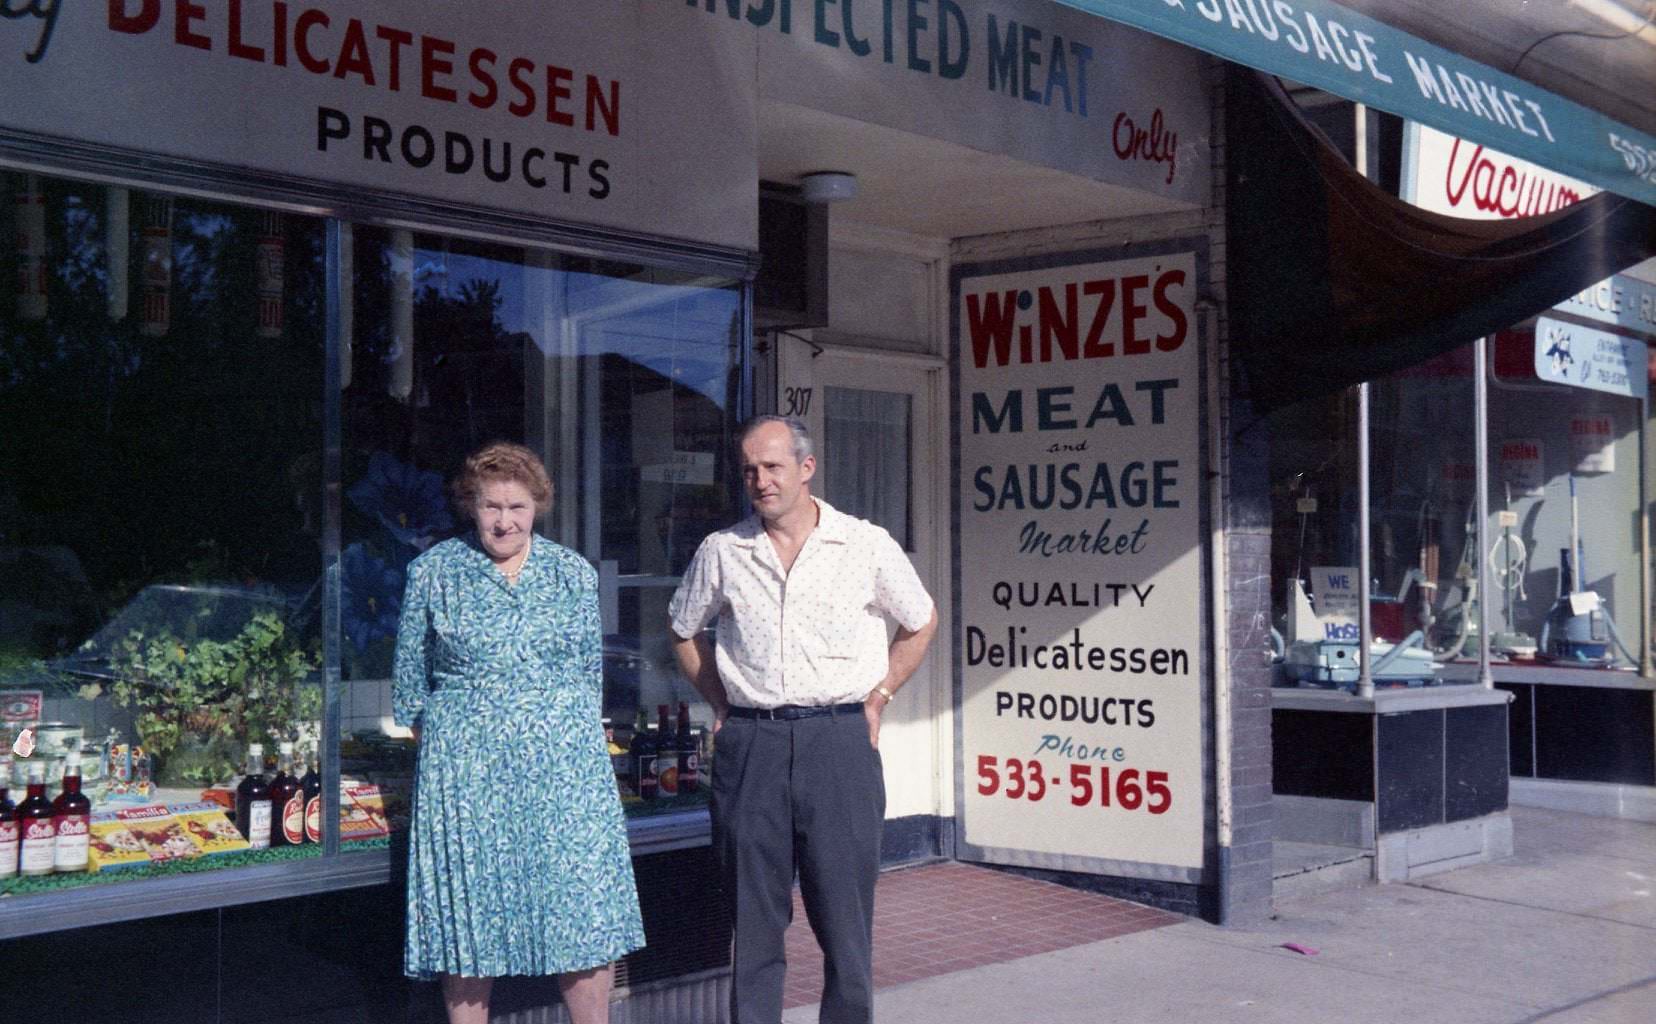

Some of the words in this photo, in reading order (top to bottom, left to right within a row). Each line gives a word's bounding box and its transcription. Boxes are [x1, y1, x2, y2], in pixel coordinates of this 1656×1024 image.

[686, 0, 970, 78] ECTED
[987, 14, 1093, 117] MEAT
[1404, 51, 1555, 142] MARKET
[317, 106, 611, 200] PRODUCTS
[1112, 108, 1178, 184] Only
[785, 386, 812, 416] 307
[972, 378, 1179, 434] MEAT
[1046, 440, 1089, 453] and
[973, 460, 1180, 512] SAUSAGE
[1018, 519, 1149, 557] Market
[992, 581, 1155, 610] QUALITY
[1328, 575, 1350, 589] WE
[966, 626, 1188, 675] Delicatessen
[996, 692, 1155, 727] PRODUCTS
[1034, 735, 1126, 761] Phone
[977, 755, 1172, 814] 533-5165
